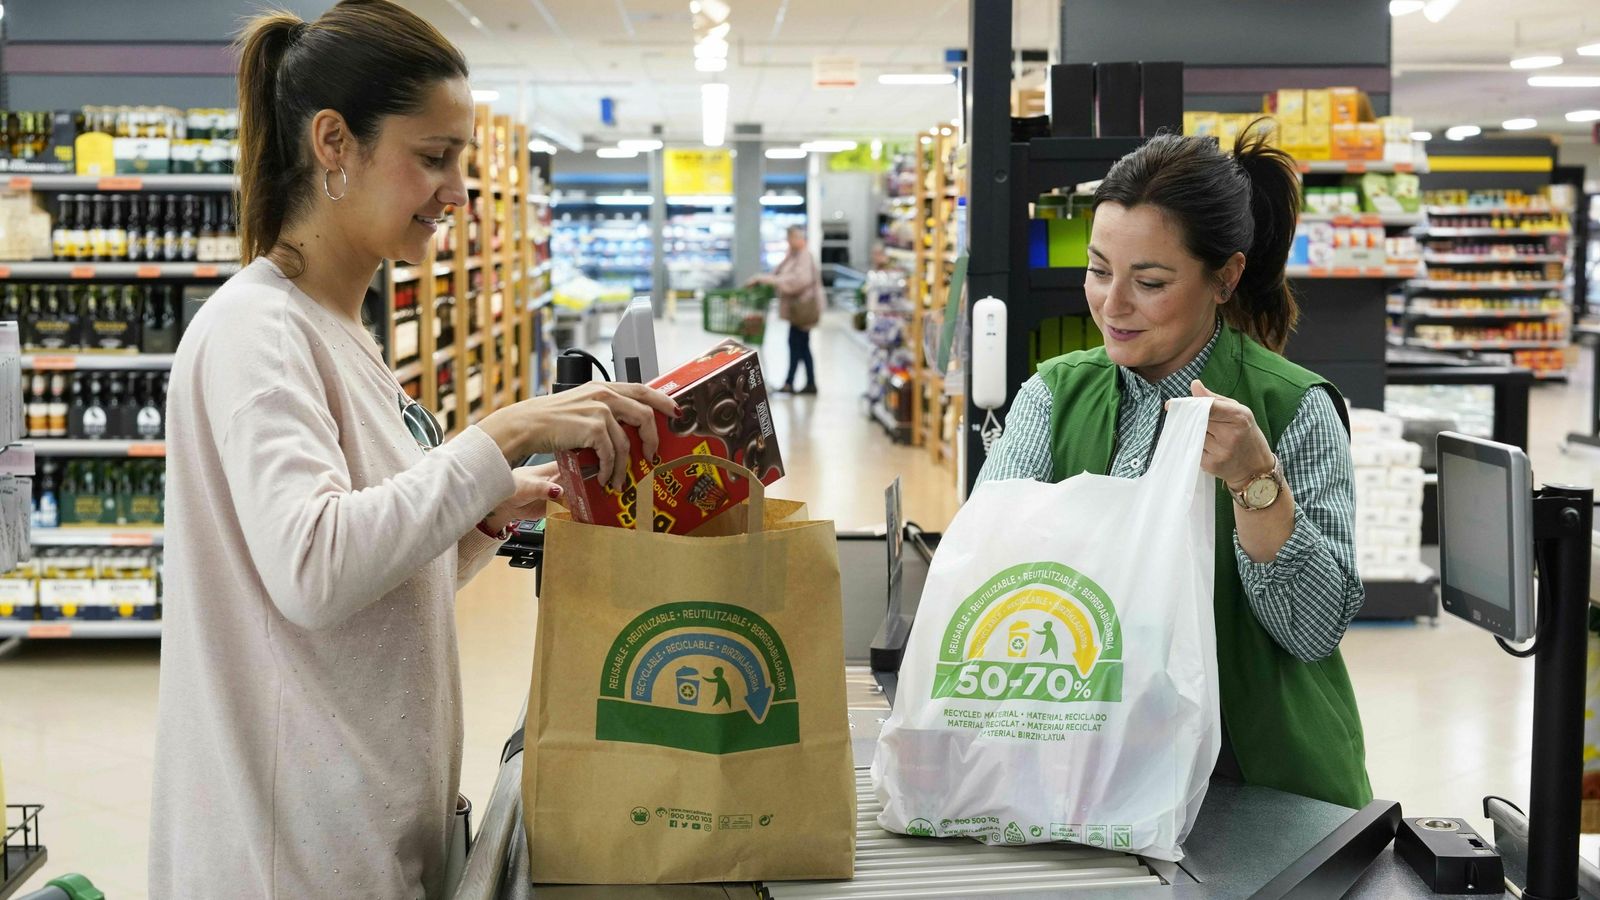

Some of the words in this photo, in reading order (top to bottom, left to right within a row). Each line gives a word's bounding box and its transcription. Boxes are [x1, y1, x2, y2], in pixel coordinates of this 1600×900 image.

[949, 616, 970, 654] REUSABLE
[970, 575, 1017, 613] REUTILIZABLE
[1023, 569, 1078, 590] REUTILITZABLE
[609, 647, 628, 690] REUSABLE
[627, 611, 676, 645] REUTILIZABLE
[682, 609, 748, 627] REUTILITZABLE
[750, 623, 787, 693] BERRERABILGARRIA
[635, 652, 664, 697] RECYCLABLE
[665, 640, 715, 655] RECICLABLE
[955, 664, 1091, 699] 50-70%
[943, 708, 982, 719] RECYCLED
[1026, 712, 1063, 721] MATERIAL
[1064, 713, 1107, 722] RECICLADO
[947, 719, 984, 729] MATERIAL
[1027, 721, 1063, 731] MATERIAU
[1065, 722, 1102, 731] RECICLAT
[670, 812, 684, 820] 900
[685, 813, 700, 821] 500
[701, 815, 713, 823] 103
